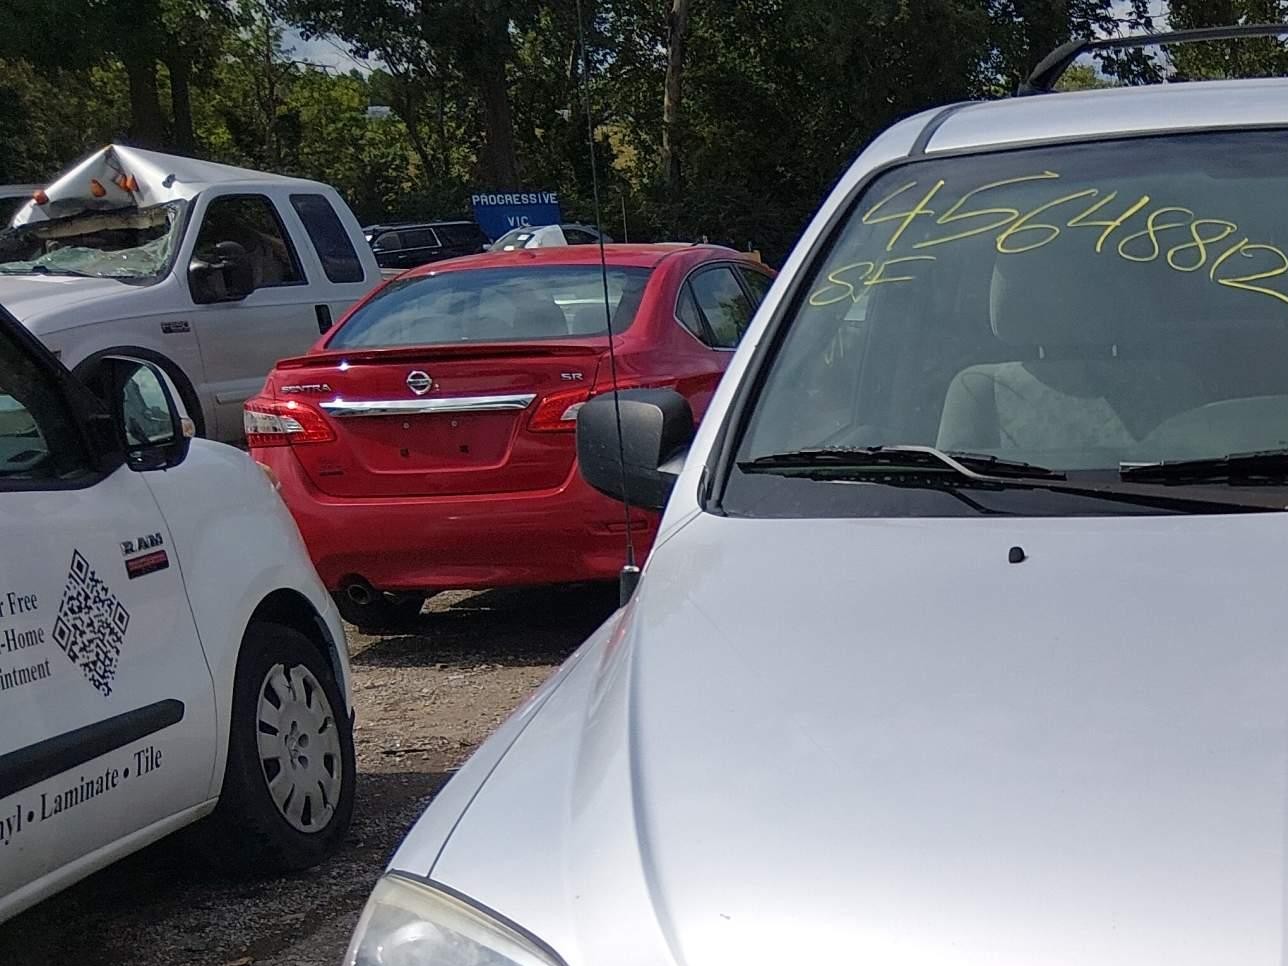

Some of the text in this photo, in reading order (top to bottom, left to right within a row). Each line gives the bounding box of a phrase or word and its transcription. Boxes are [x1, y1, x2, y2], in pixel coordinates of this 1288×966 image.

[471, 192, 559, 206] PROGRESSIVE
[507, 216, 532, 227] VIC
[560, 373, 583, 381] SR
[281, 384, 332, 393] SENTRA
[121, 532, 163, 555] RAM
[7, 592, 38, 615] Free
[40, 768, 119, 822] Laminate
[134, 746, 162, 778] Tile
